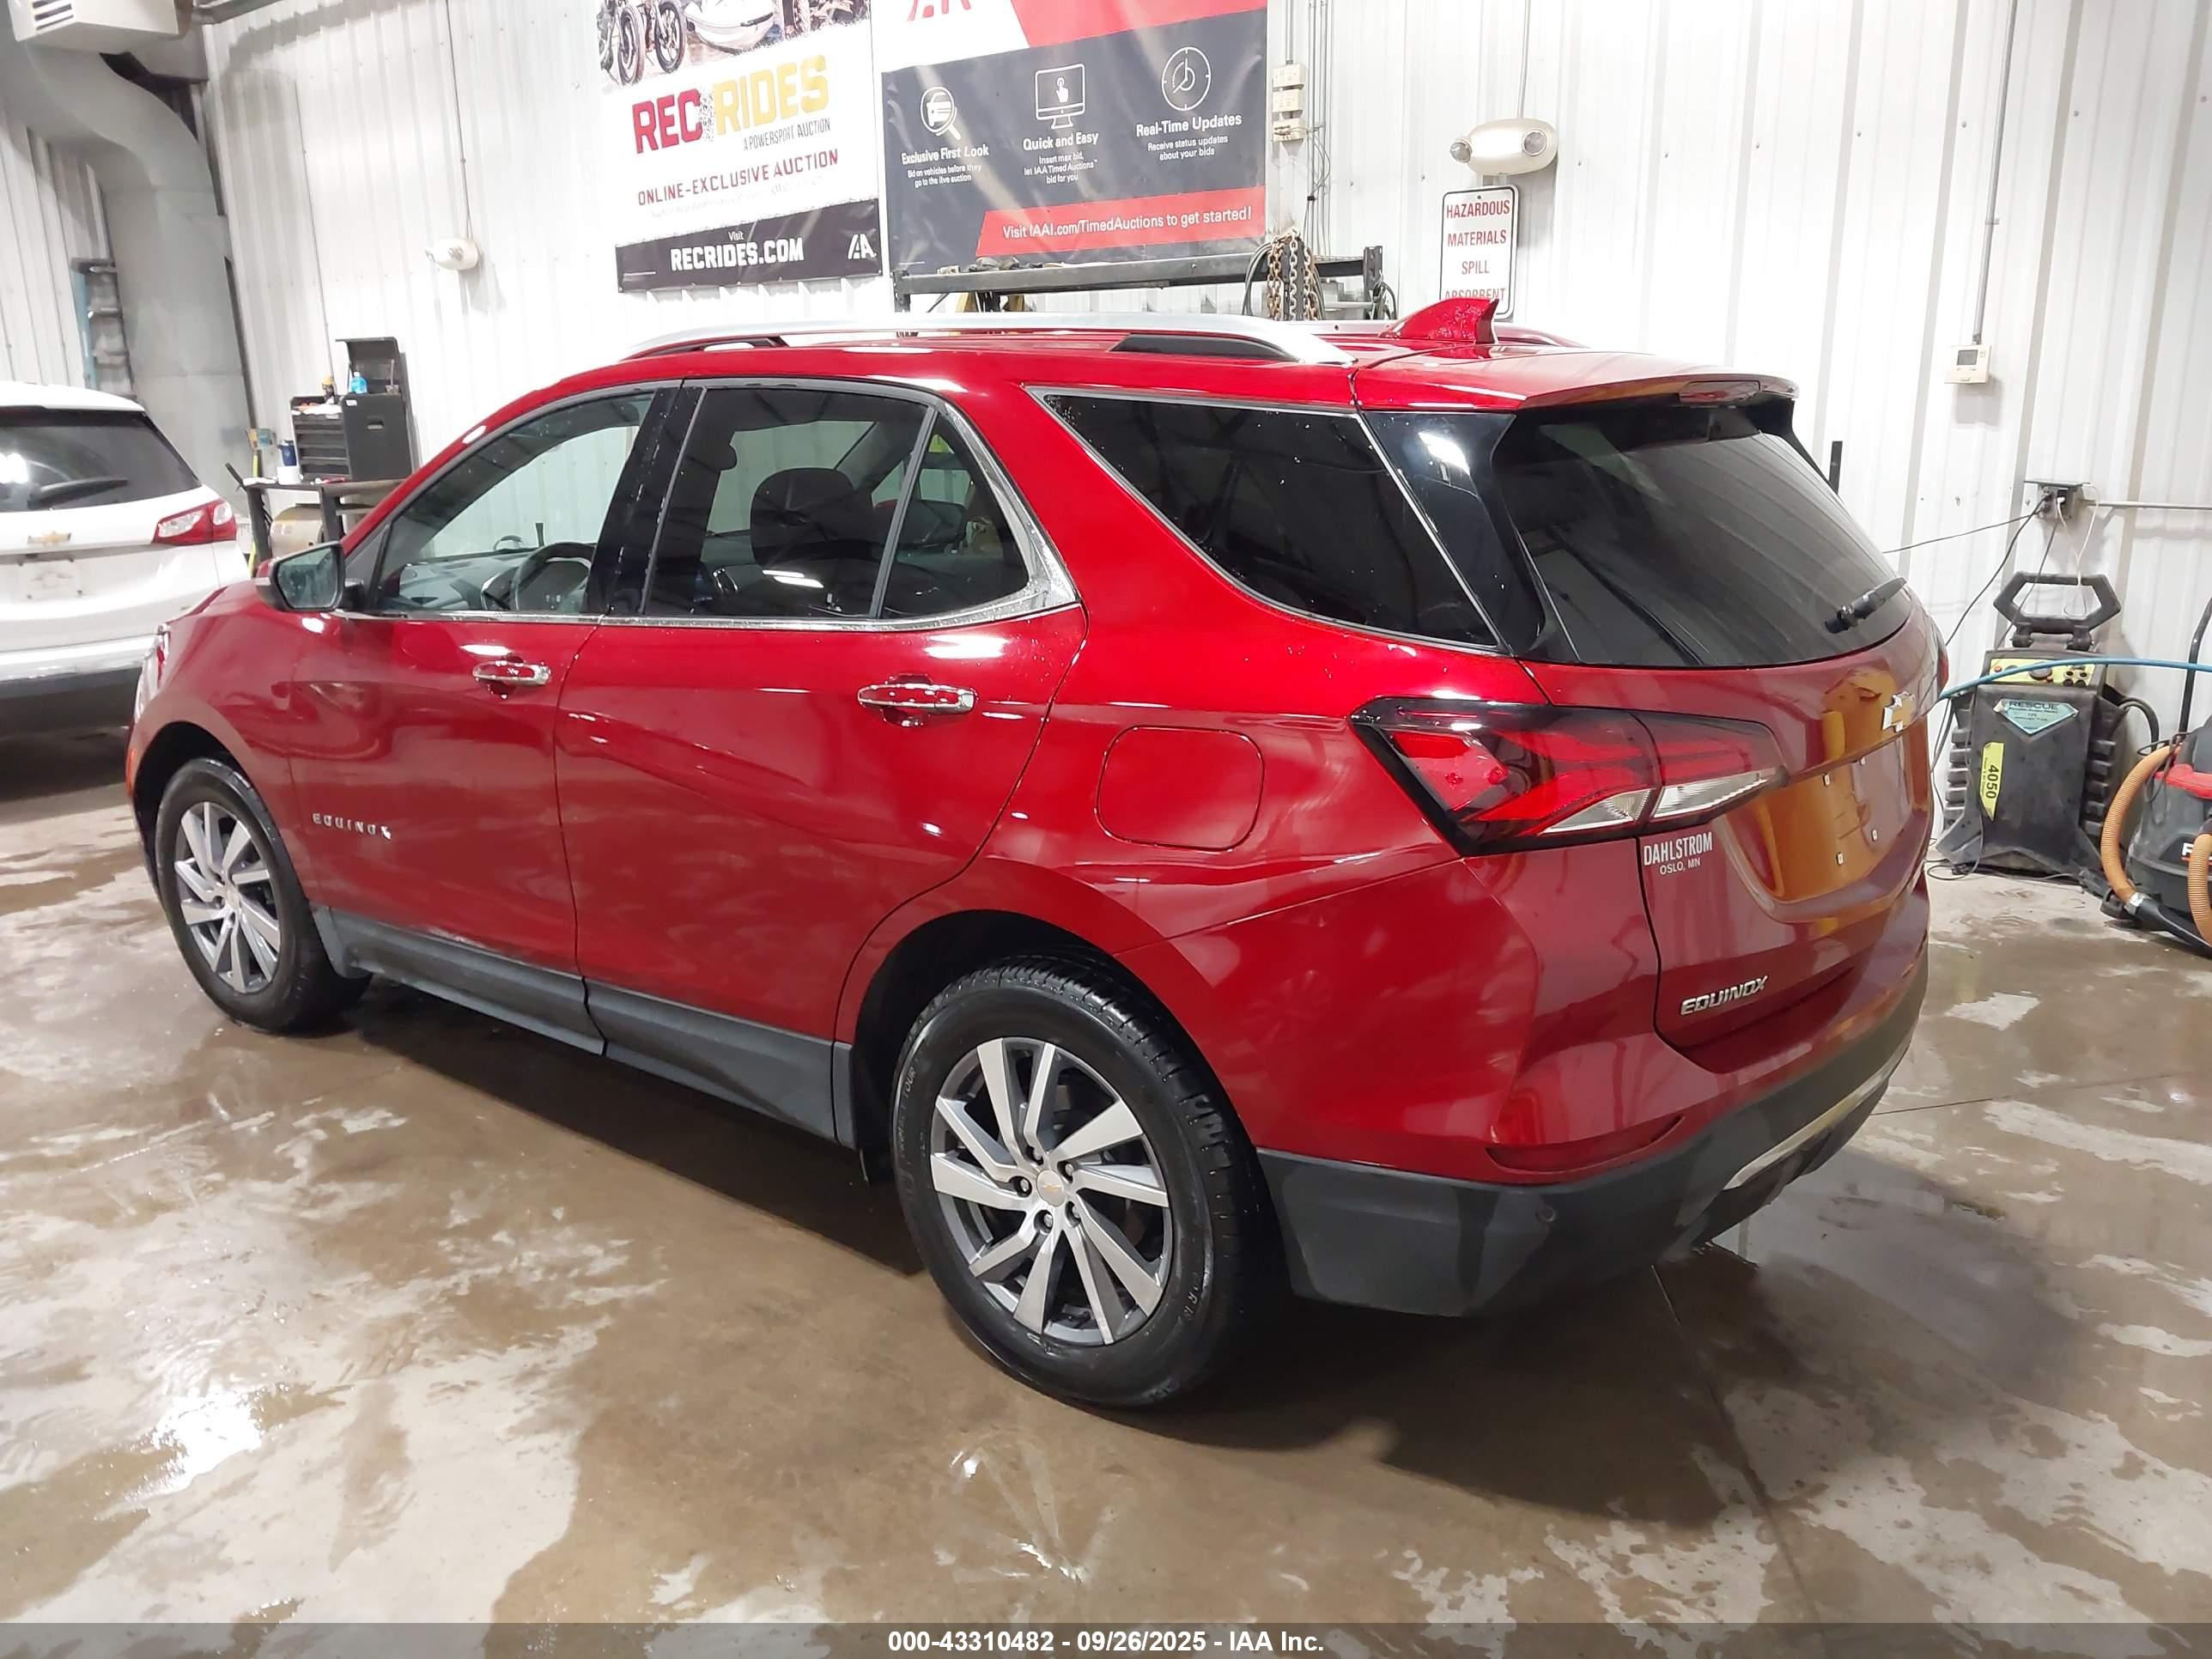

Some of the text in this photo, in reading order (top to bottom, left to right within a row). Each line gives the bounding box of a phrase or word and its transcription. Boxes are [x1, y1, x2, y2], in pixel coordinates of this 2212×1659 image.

[632, 54, 830, 154] REC RIDES
[744, 117, 830, 151] A POWERSPORT AUCTION
[1136, 114, 1243, 137] Real-Time Updates
[1023, 131, 1099, 151] Quick and Easy
[1147, 135, 1229, 152] Receive status updates
[901, 143, 990, 165] Exclusive First Look
[1039, 155, 1058, 165] Insert
[1058, 154, 1072, 163] max
[1159, 146, 1215, 161] about your bids
[638, 164, 769, 206] ONLINE-EXCLUSIVE
[773, 148, 838, 178] AUCTION
[907, 169, 915, 179] Bid
[924, 167, 947, 176] vehicles
[947, 164, 966, 173] before
[967, 163, 982, 173] they
[1024, 167, 1033, 176] let
[1034, 165, 1048, 175] IAA
[1048, 163, 1066, 174] Timed
[1046, 173, 1079, 185] bid for you
[915, 179, 922, 188] go
[928, 177, 939, 185] the
[939, 175, 950, 185] live
[951, 173, 972, 183] auction
[1446, 199, 1510, 219] HAZARDOUS
[1003, 206, 1251, 239] Visit IAAI.com/TimedAuctions to get started!
[728, 231, 744, 241] Visit
[1448, 229, 1507, 247] MATERIALS
[670, 237, 805, 271] RECRIDES.COM
[1462, 260, 1490, 275] SPILL
[2008, 701, 2058, 710] RESCUE
[1985, 764, 2000, 799] 4050
[1644, 831, 1713, 866] DAHLSTROM
[1659, 857, 1701, 876] OSLO, MN
[1680, 975, 1769, 1016] EQUINOX
